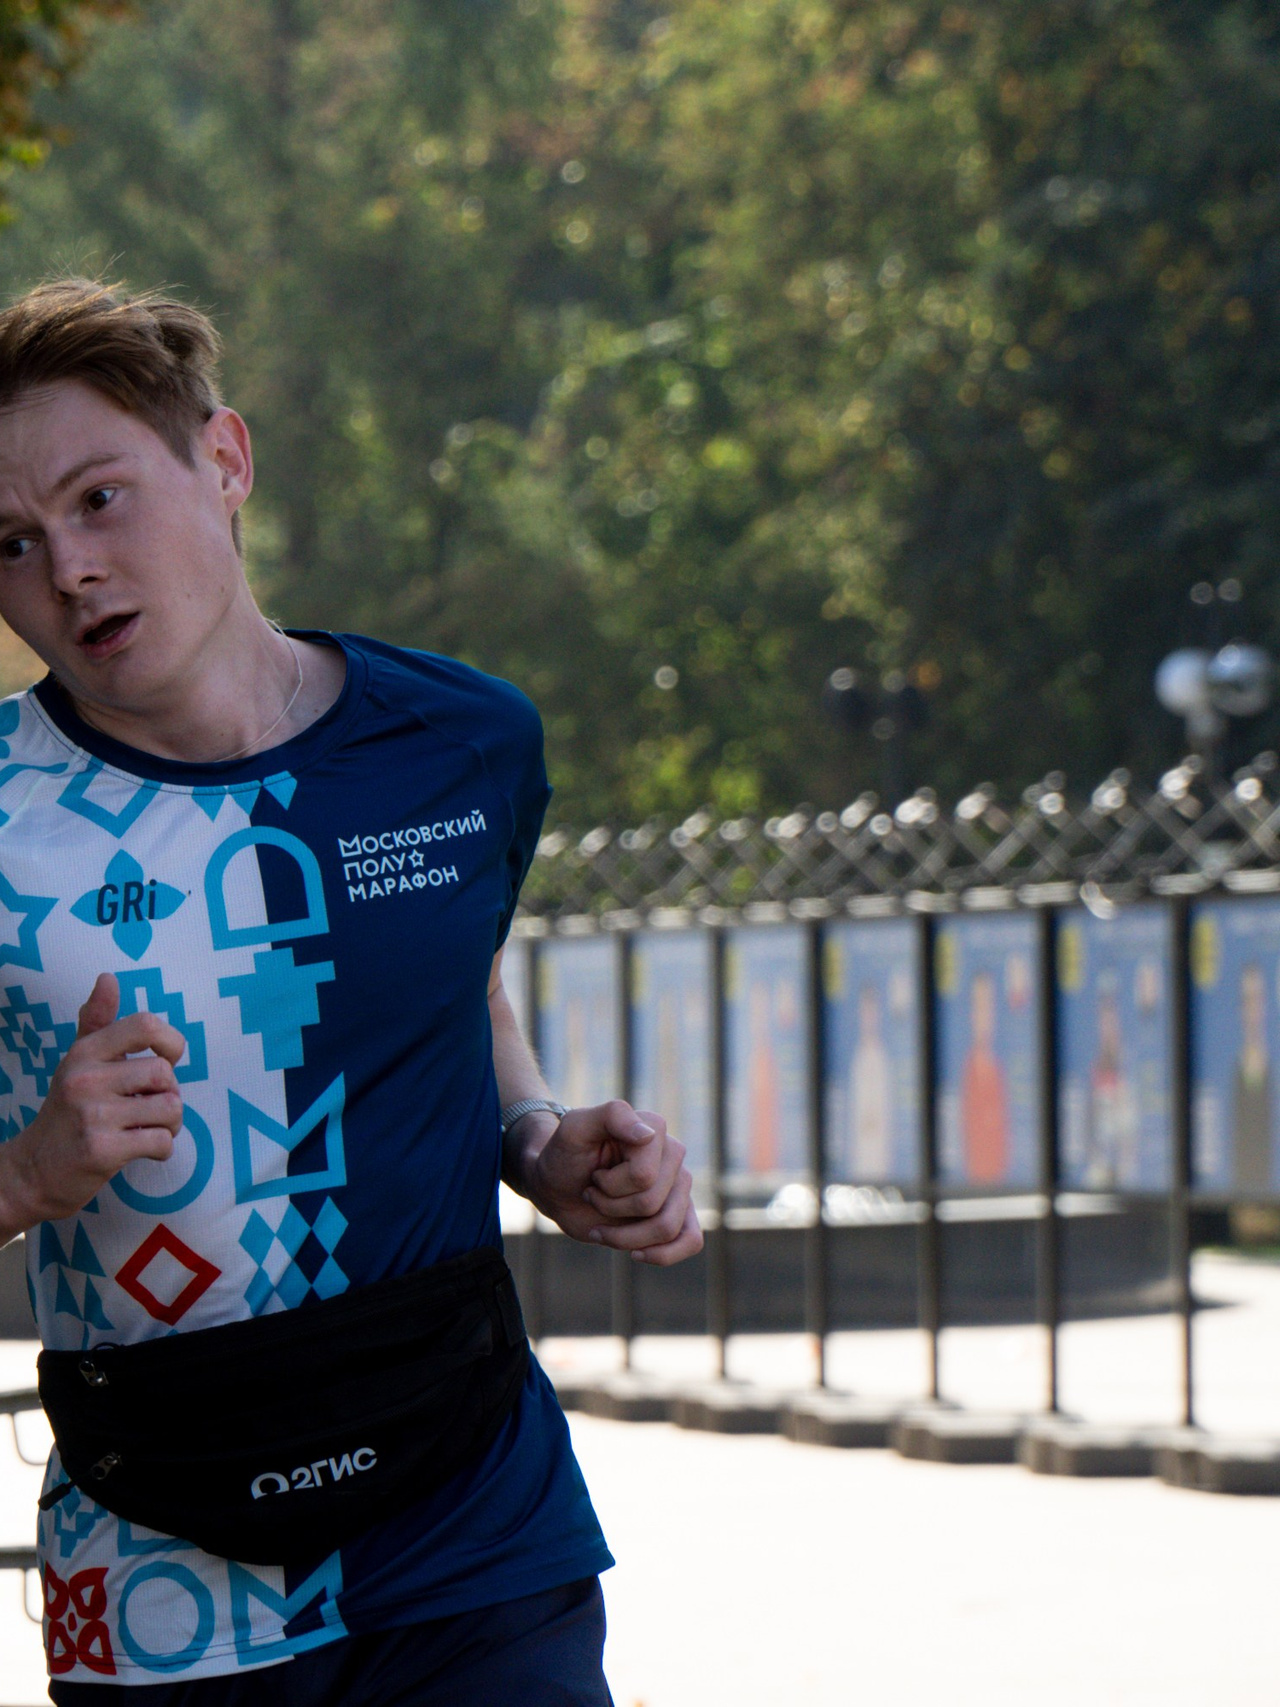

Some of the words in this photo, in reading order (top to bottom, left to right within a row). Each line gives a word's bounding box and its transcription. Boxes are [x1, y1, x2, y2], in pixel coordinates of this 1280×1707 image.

[343, 852, 406, 881] ПОЛУ
[348, 865, 459, 902] МАРАФОН
[96, 878, 157, 925] GRi
[291, 1447, 378, 1490] 2ГИС
